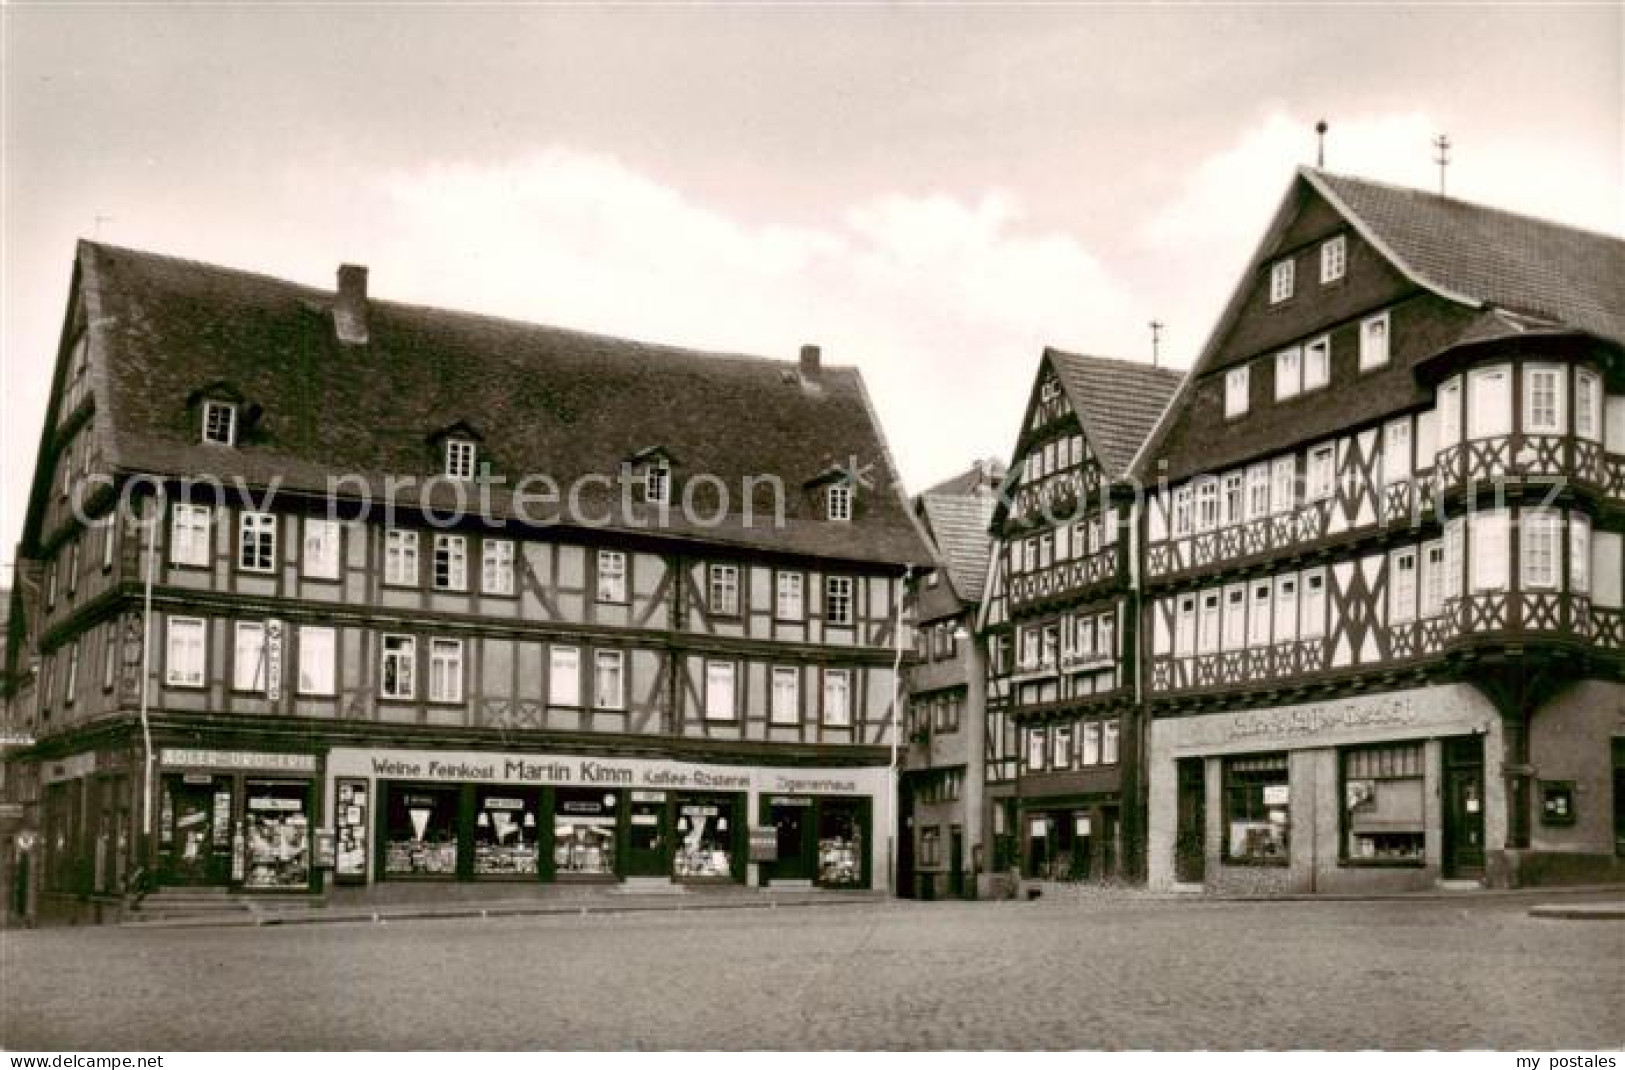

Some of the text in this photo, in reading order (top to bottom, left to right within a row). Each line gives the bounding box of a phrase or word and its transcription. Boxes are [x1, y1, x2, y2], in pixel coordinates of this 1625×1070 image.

[371, 757, 421, 775] Weine
[429, 760, 495, 779] Feinkost
[504, 758, 571, 782] Martin
[580, 761, 633, 783] Kimm
